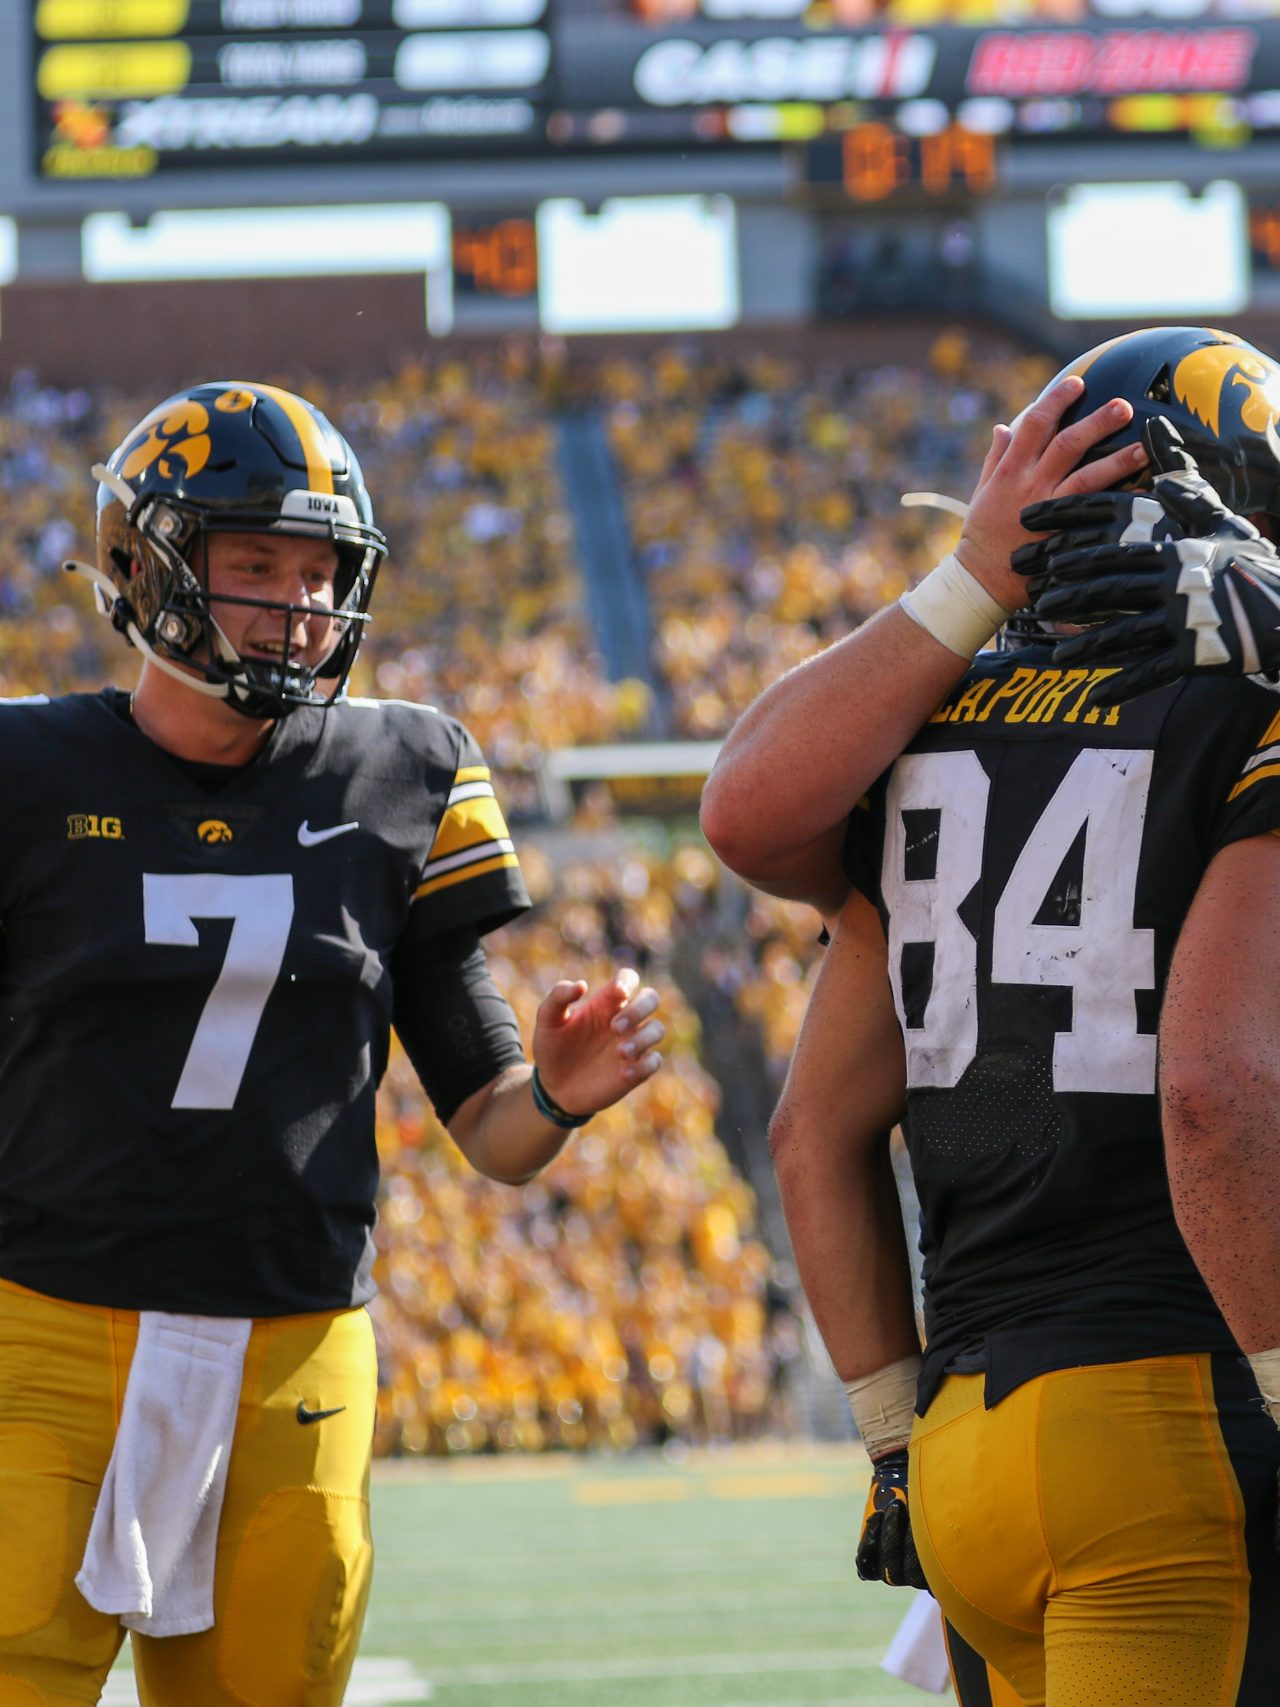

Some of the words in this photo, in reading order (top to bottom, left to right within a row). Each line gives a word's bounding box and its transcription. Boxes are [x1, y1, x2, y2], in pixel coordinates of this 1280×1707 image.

[308, 497, 339, 513] IOWA
[142, 872, 295, 1111] 7
[880, 747, 1158, 1095] 84
